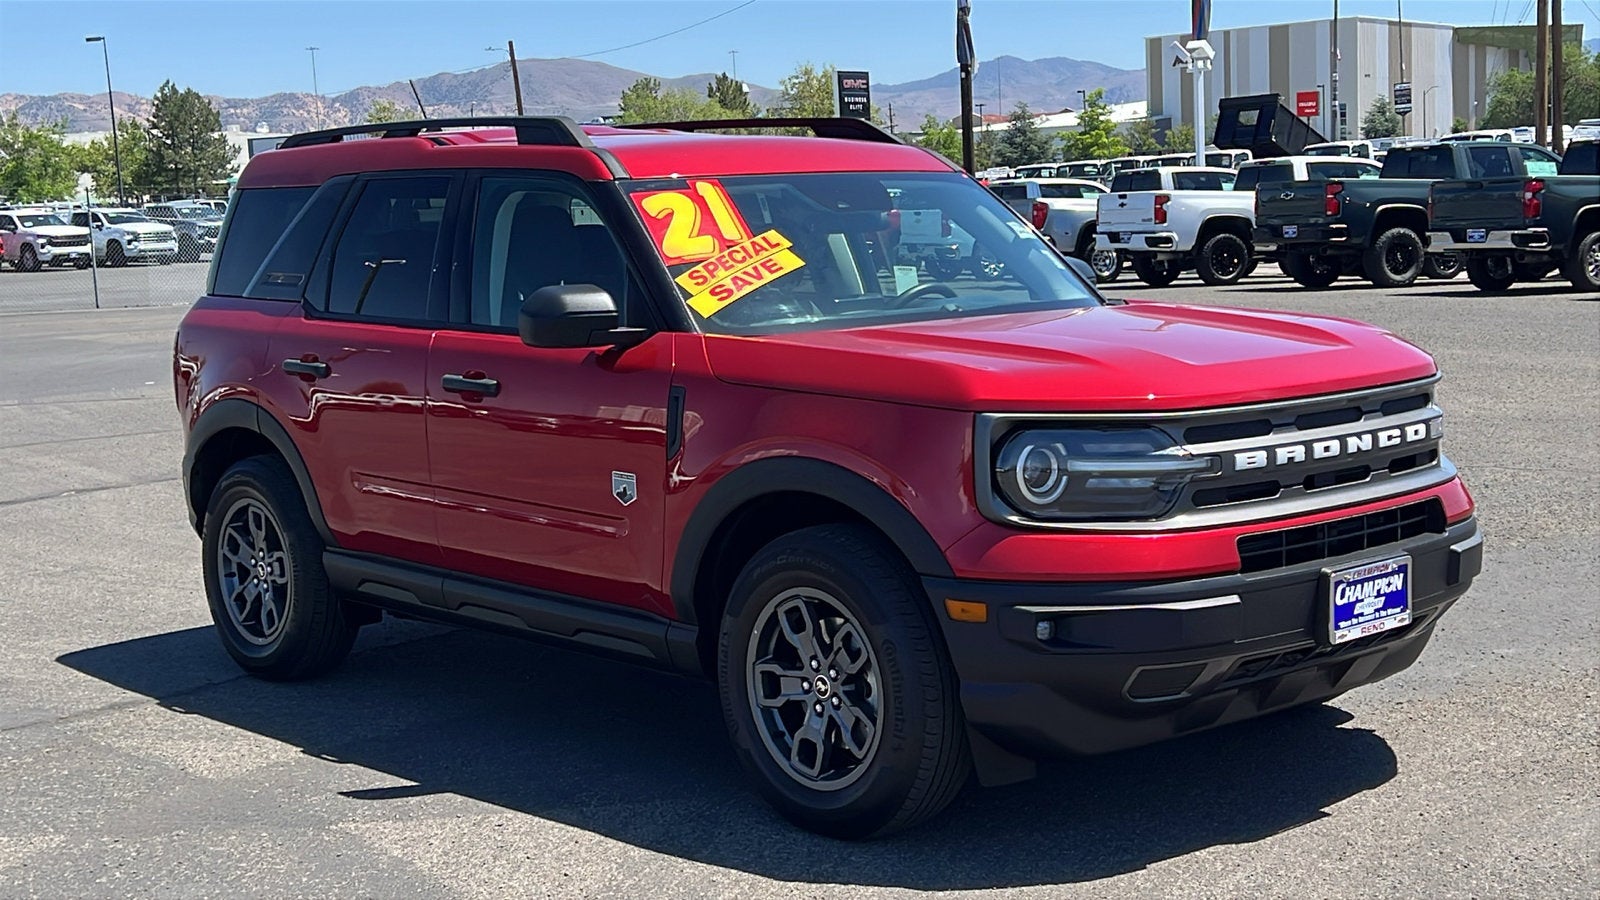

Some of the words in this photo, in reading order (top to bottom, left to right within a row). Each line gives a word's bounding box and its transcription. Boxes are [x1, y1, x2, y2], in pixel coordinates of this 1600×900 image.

[843, 79, 867, 88] GMC
[641, 181, 746, 259] 21
[688, 235, 780, 287] SPECIAL
[708, 258, 784, 302] SAVE
[1234, 423, 1426, 471] BRONCO
[1335, 573, 1404, 606] CHAMPION
[1361, 622, 1385, 635] RENO
